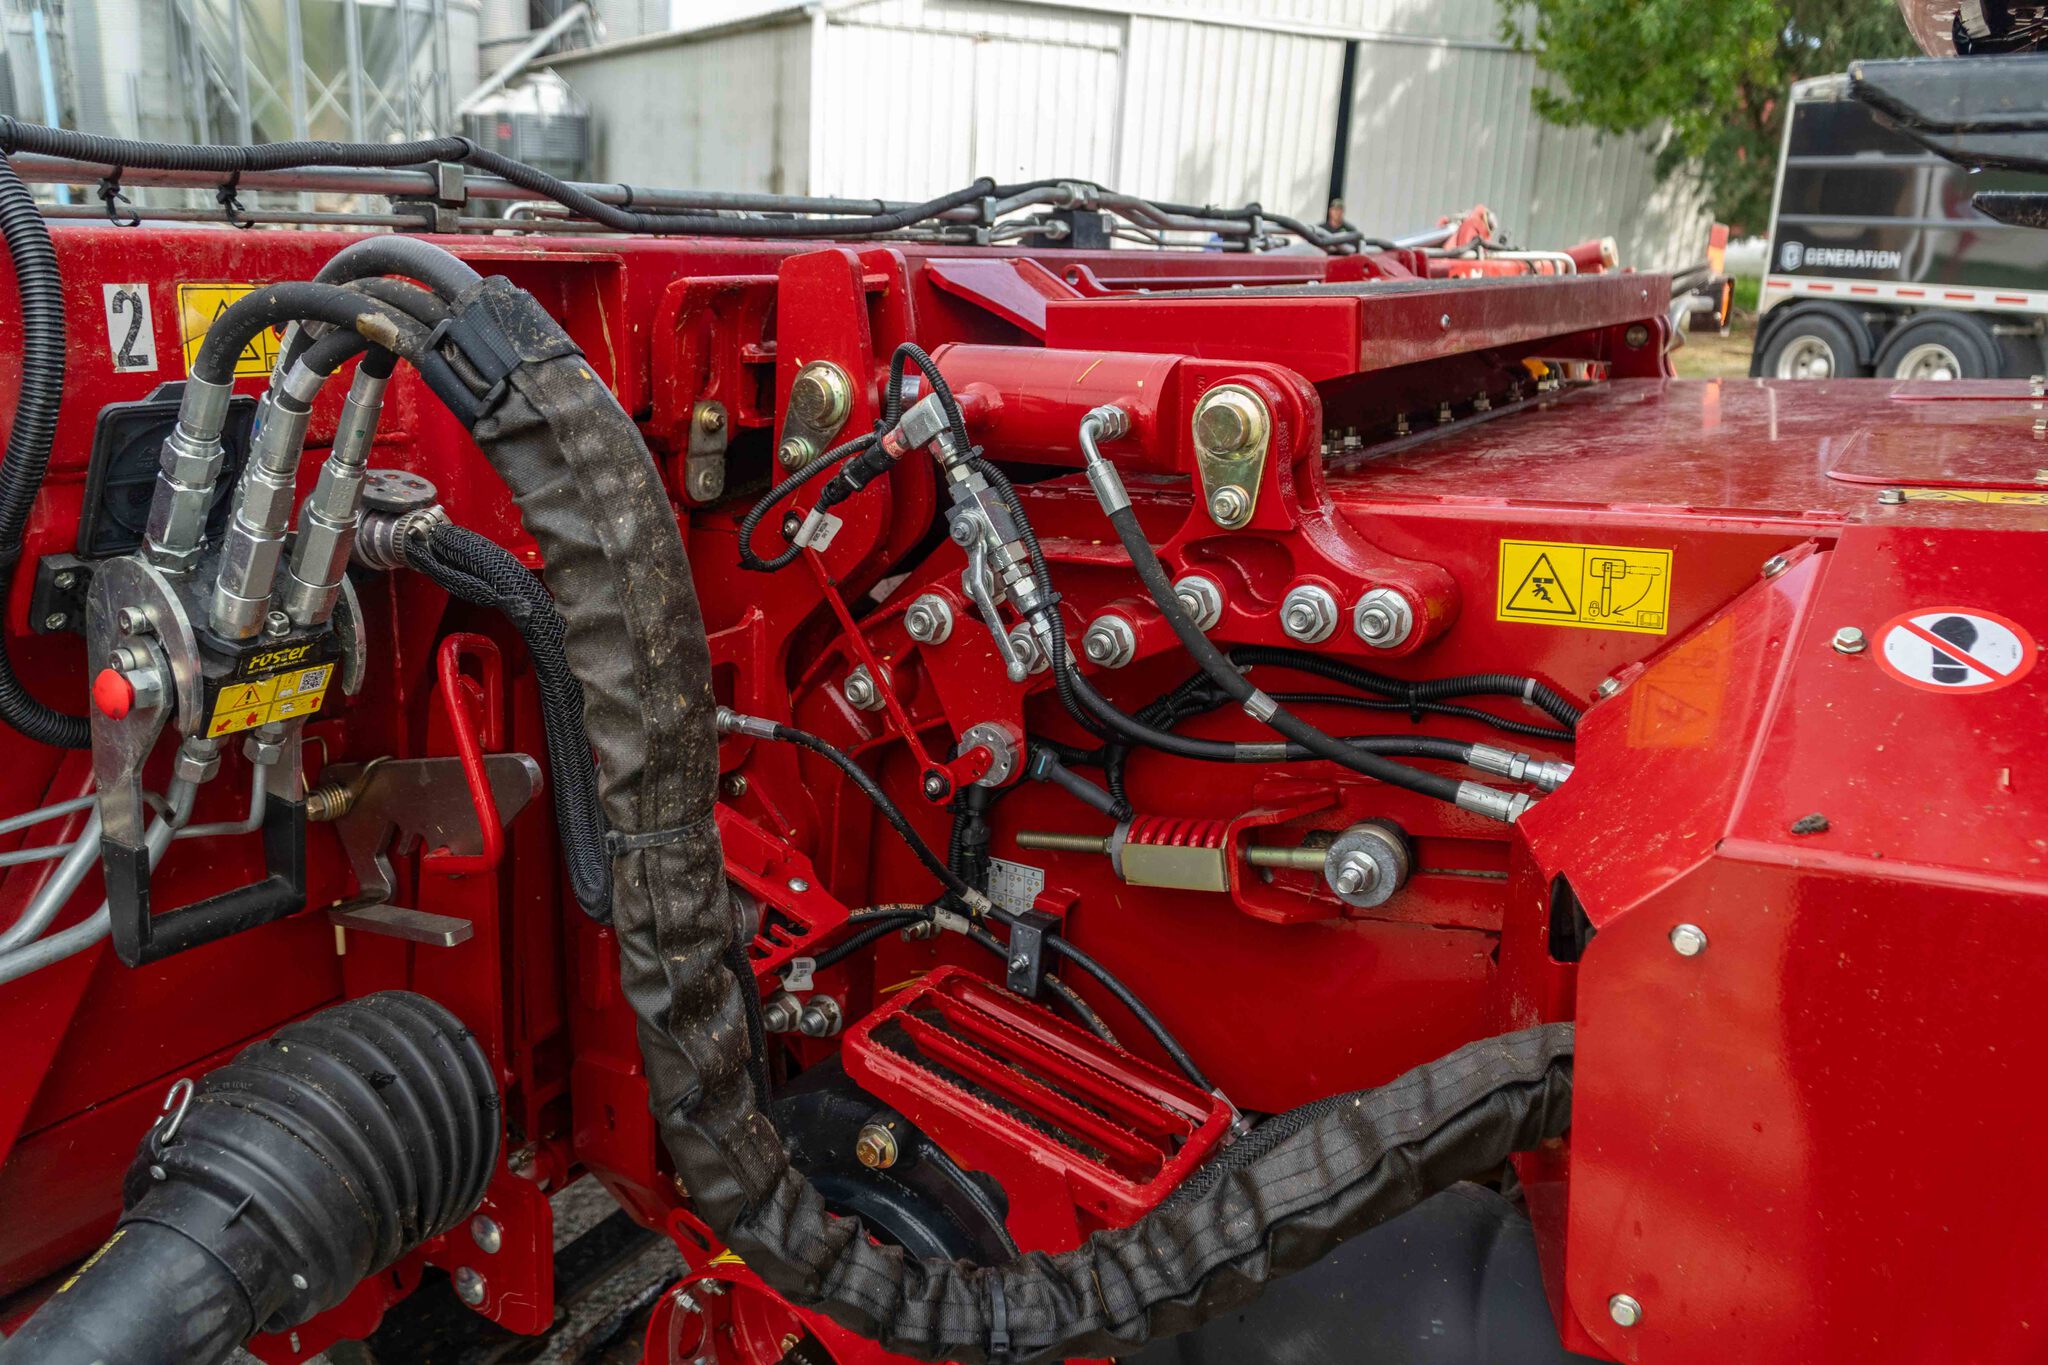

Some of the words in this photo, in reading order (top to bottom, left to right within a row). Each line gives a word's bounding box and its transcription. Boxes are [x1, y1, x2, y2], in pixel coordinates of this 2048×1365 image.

[1804, 247, 1901, 269] GENERATION
[112, 289, 149, 367] 2
[879, 903, 896, 911] SAE
